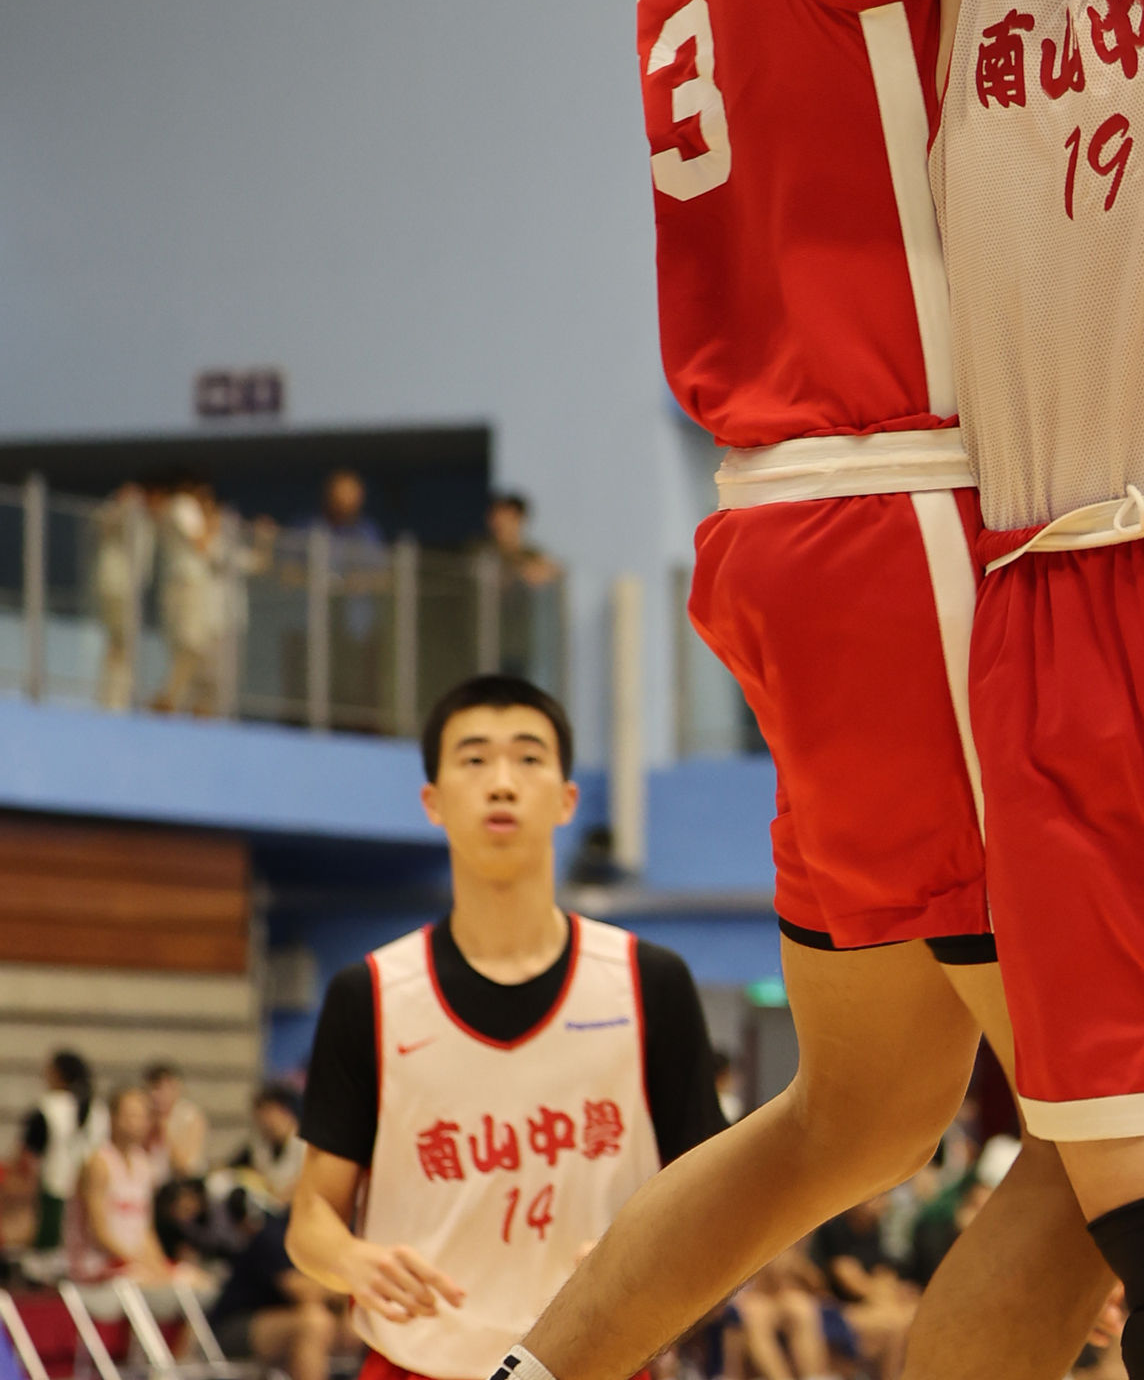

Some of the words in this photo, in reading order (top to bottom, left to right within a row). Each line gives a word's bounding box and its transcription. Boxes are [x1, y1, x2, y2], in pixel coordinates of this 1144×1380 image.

[1064, 113, 1134, 221] 19
[416, 1098, 624, 1183] 南山中學
[503, 1183, 555, 1244] 14
